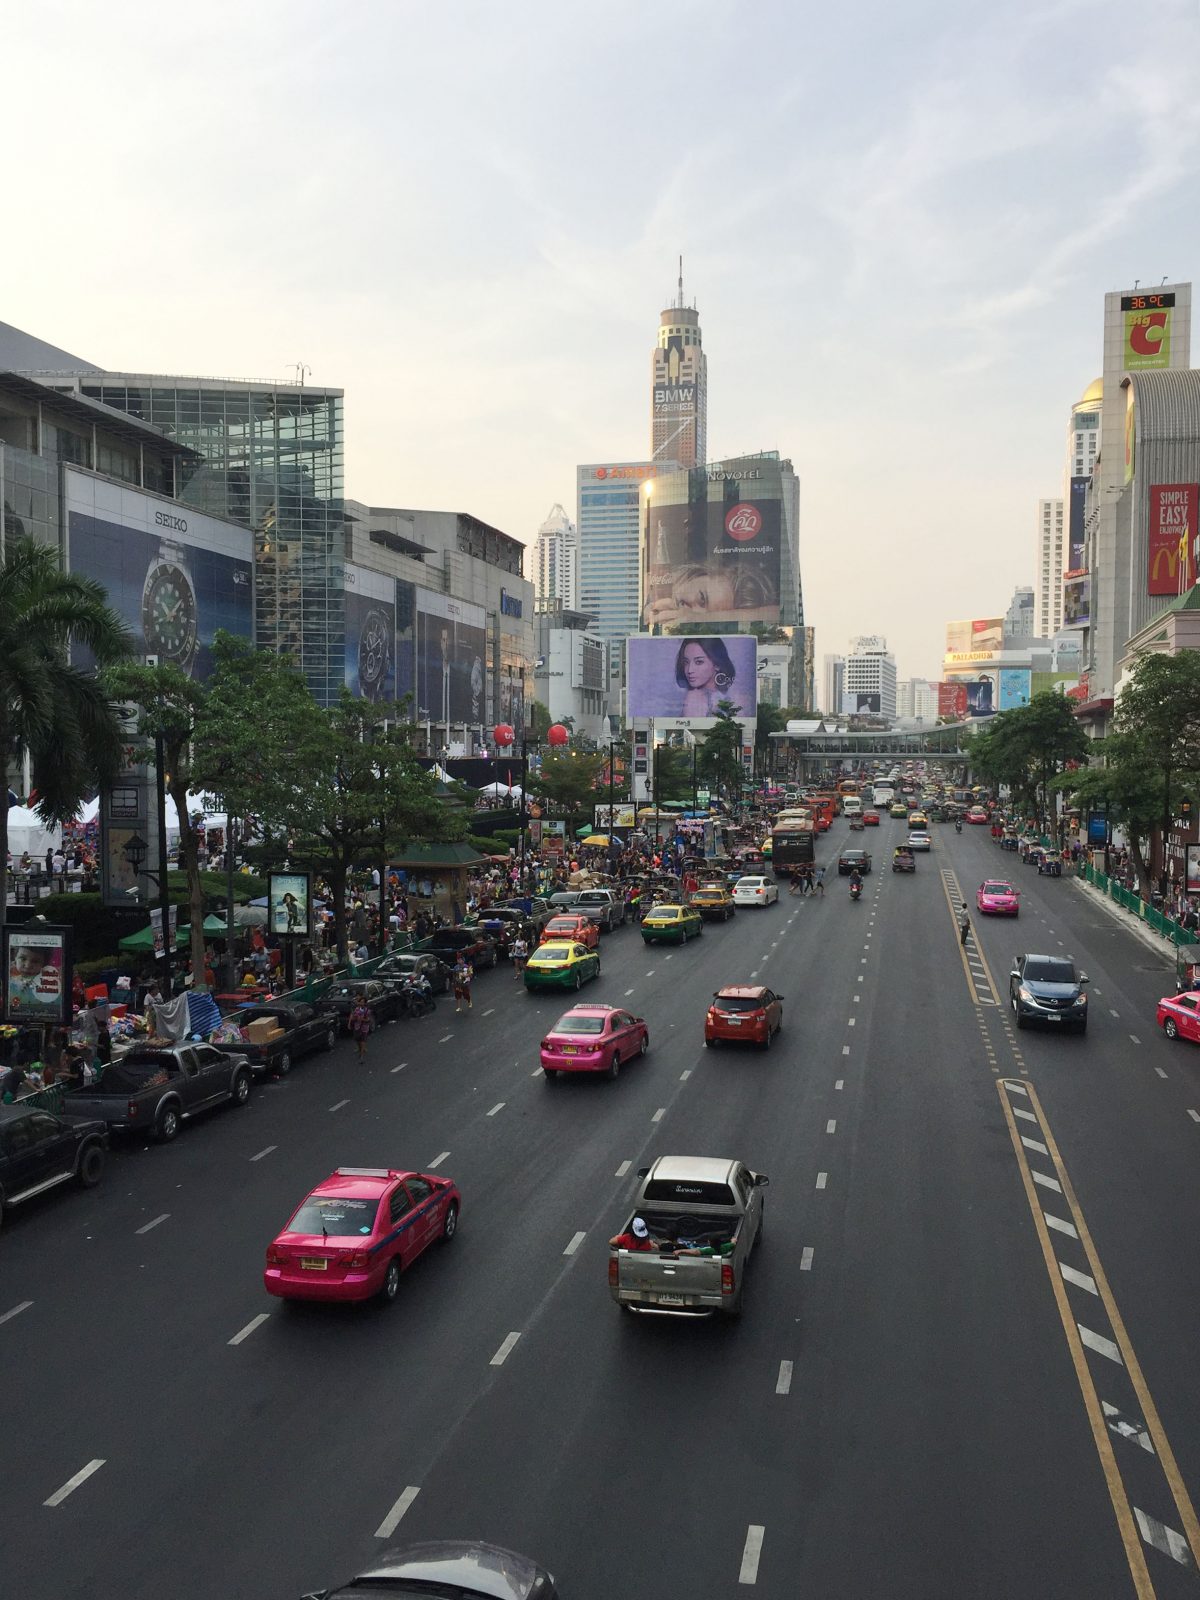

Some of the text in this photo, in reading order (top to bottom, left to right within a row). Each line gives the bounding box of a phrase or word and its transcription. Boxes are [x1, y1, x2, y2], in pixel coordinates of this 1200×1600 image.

[1131, 297, 1145, 309] 36
[1128, 315, 1151, 327] Big
[655, 388, 694, 403] BMW
[655, 402, 694, 412] 7 SERIES
[708, 469, 762, 482] NOVOTEL
[1160, 491, 1189, 505] SIMPLE
[1159, 505, 1188, 525] EASY
[154, 511, 188, 533] SEIKO
[952, 652, 993, 662] PALLADIUM
